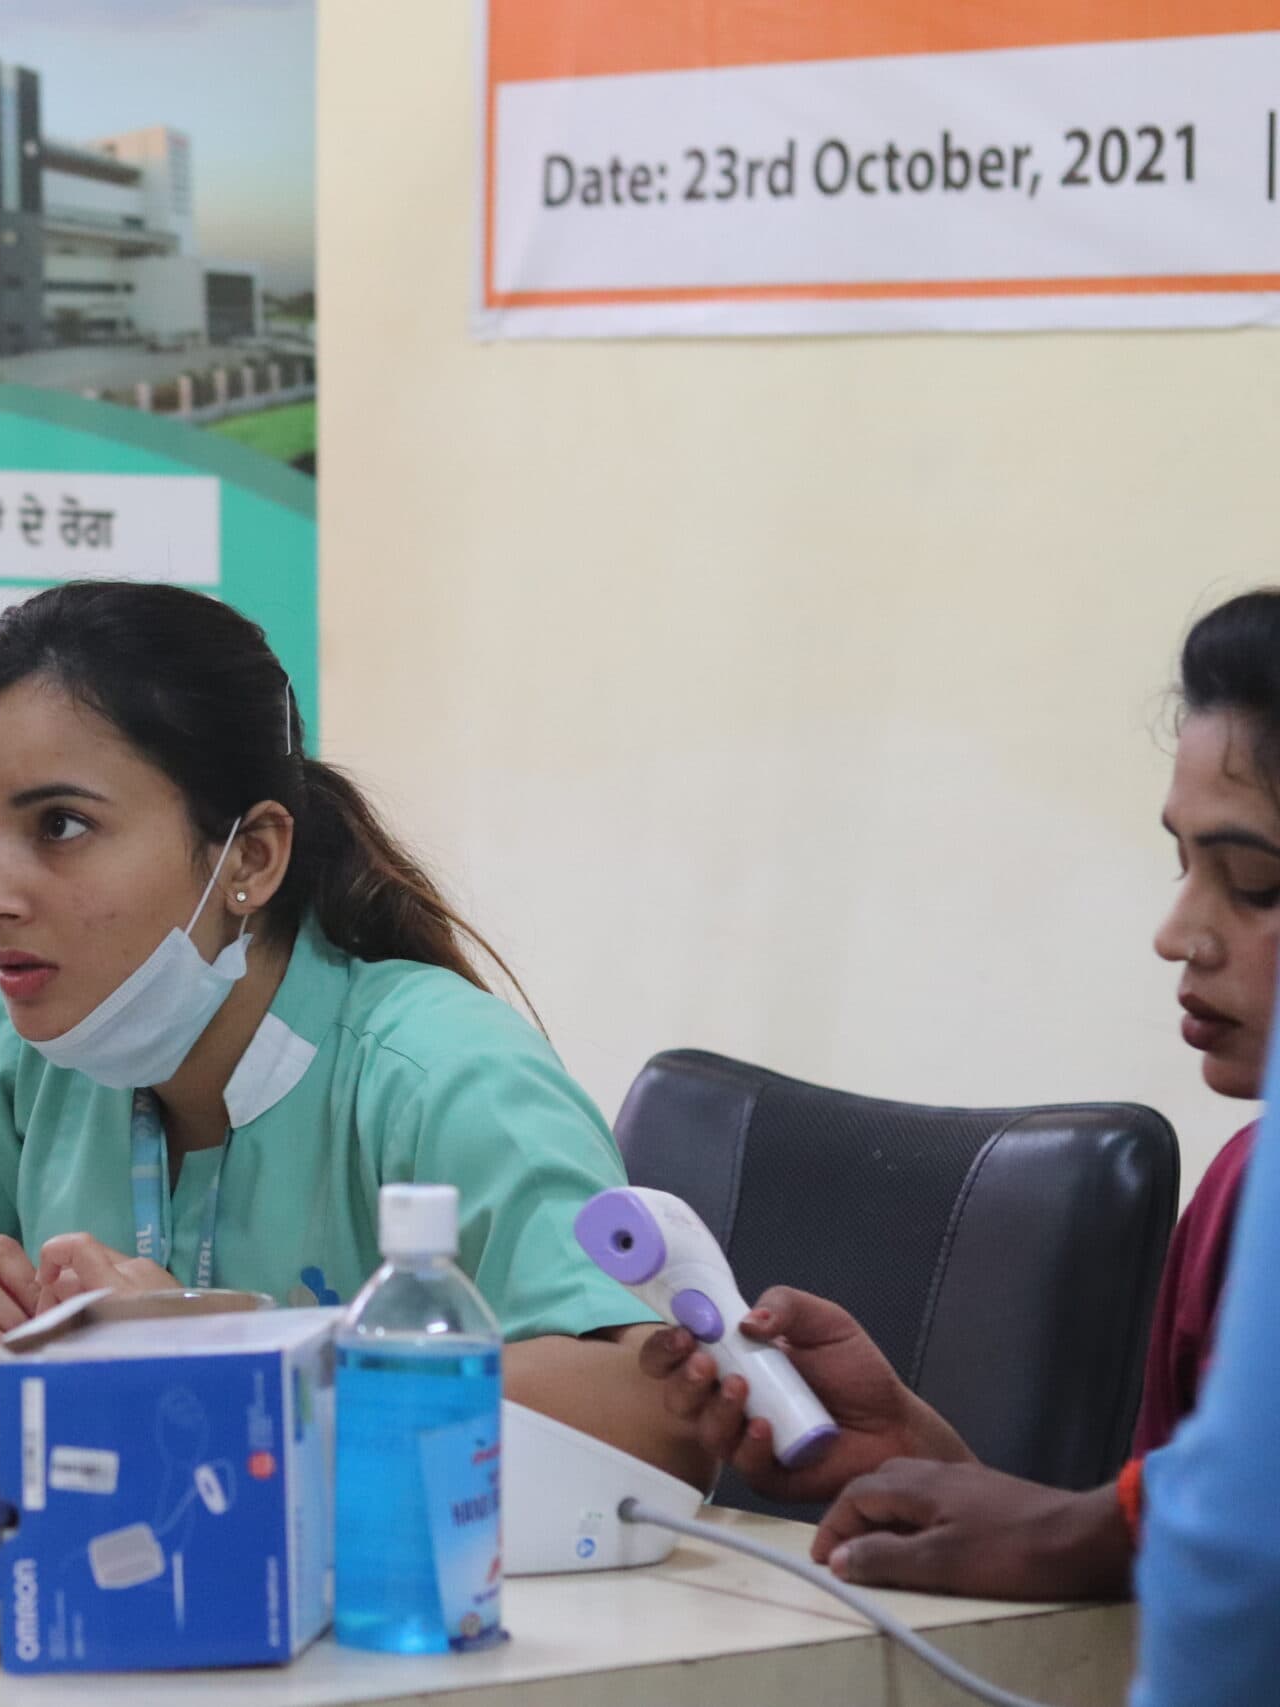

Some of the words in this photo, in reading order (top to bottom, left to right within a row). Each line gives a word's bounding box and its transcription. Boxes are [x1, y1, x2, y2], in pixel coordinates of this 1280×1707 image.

[542, 154, 668, 210] Date:
[682, 139, 796, 203] 23rd
[813, 130, 1041, 198] October,
[1060, 123, 1197, 187] 2021
[18, 493, 48, 547] ਦੇ
[58, 495, 117, 549] ਰੋਗ
